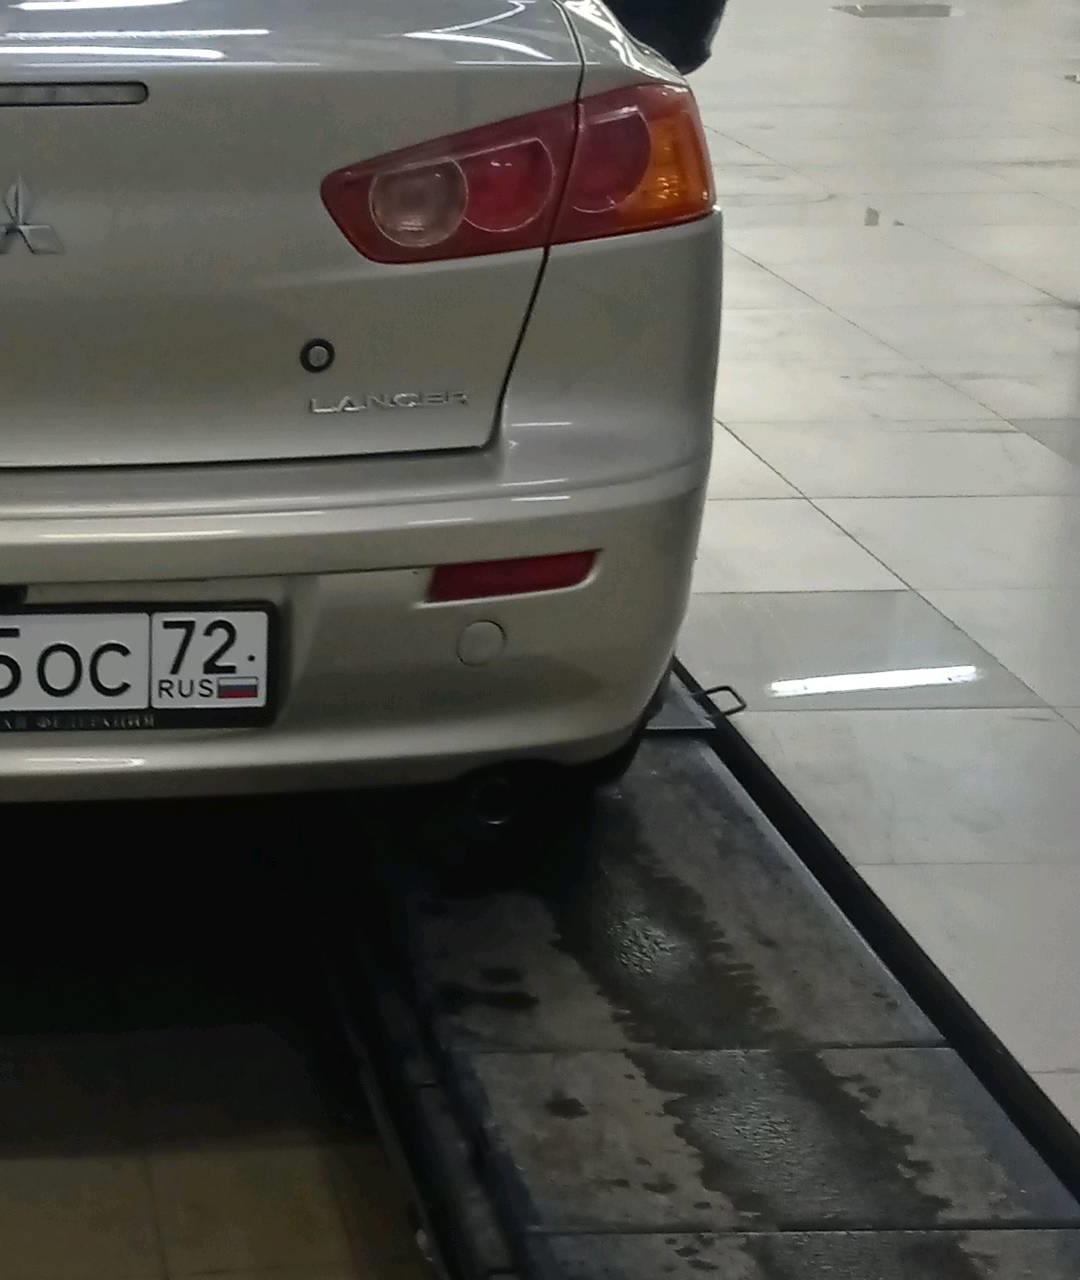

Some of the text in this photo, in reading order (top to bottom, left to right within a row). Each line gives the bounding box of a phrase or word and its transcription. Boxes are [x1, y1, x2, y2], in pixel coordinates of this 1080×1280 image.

[309, 392, 469, 414] LANCER
[162, 619, 237, 675] 72
[157, 678, 215, 699] RUS
